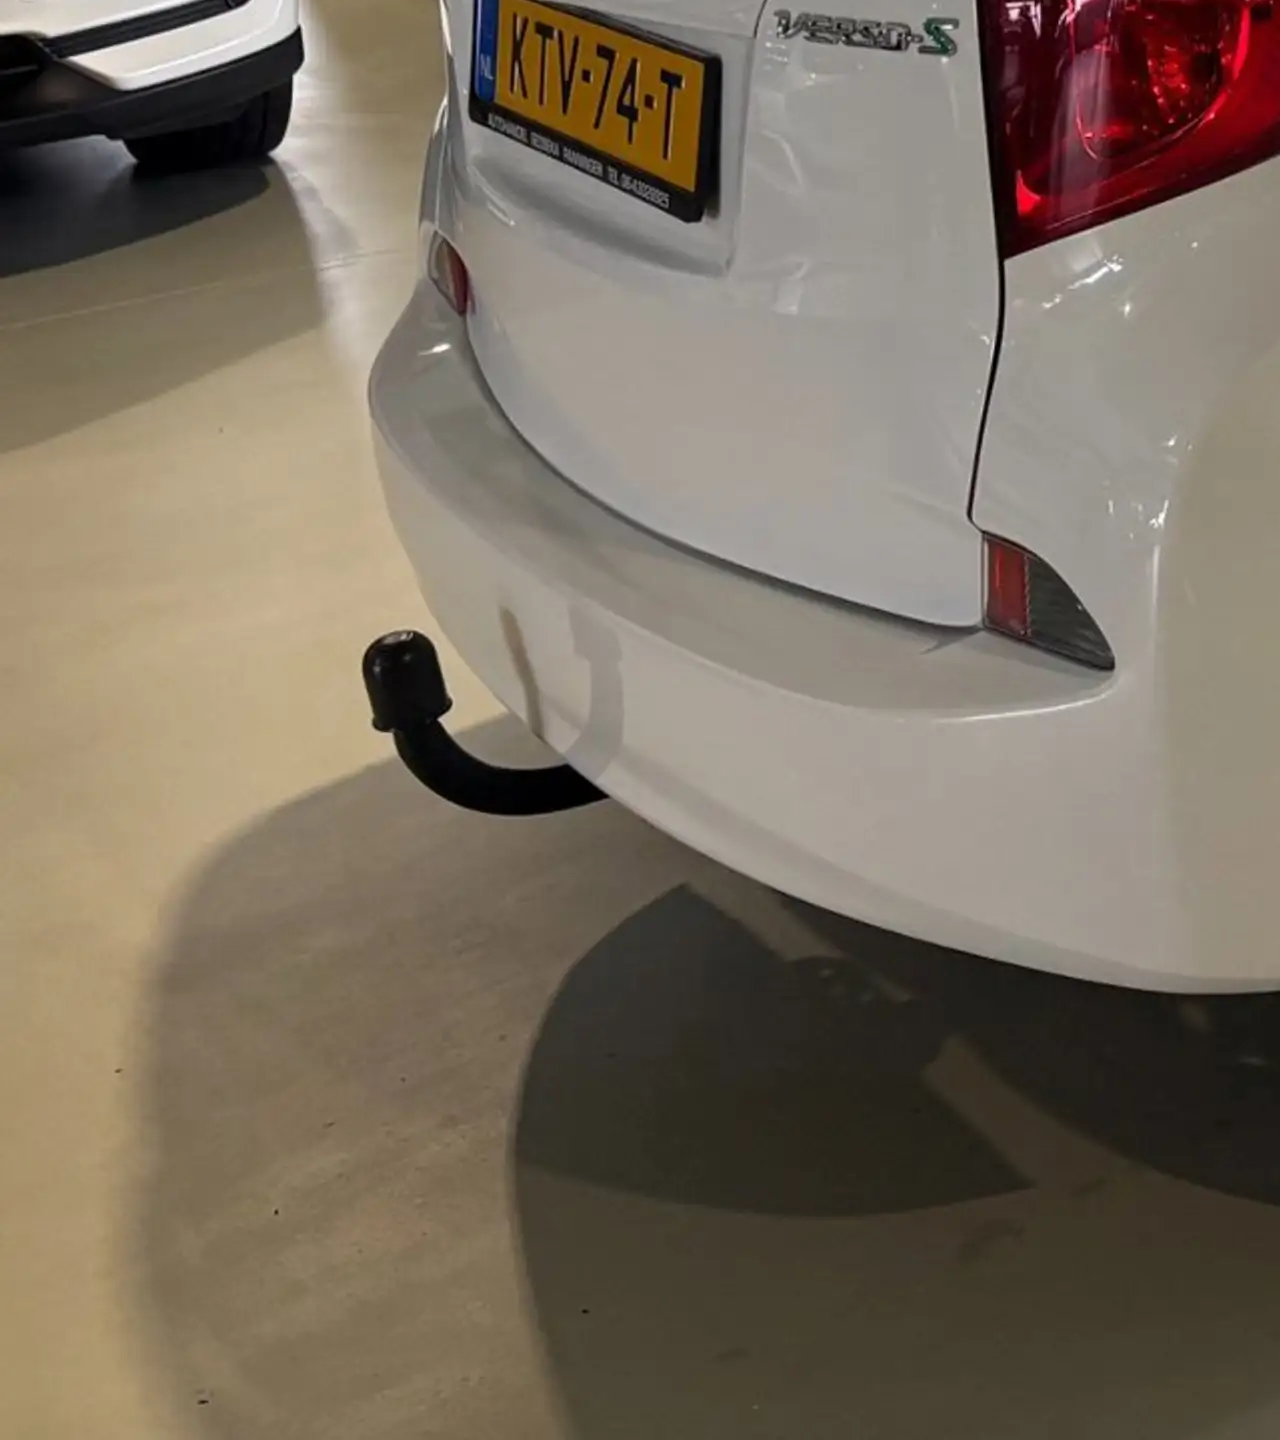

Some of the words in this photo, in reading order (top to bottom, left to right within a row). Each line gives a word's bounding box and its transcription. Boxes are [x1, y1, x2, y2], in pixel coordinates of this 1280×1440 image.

[774, 9, 960, 57] VERSO-S
[480, 53, 495, 80] NL
[510, 12, 686, 162] KTV-74-T
